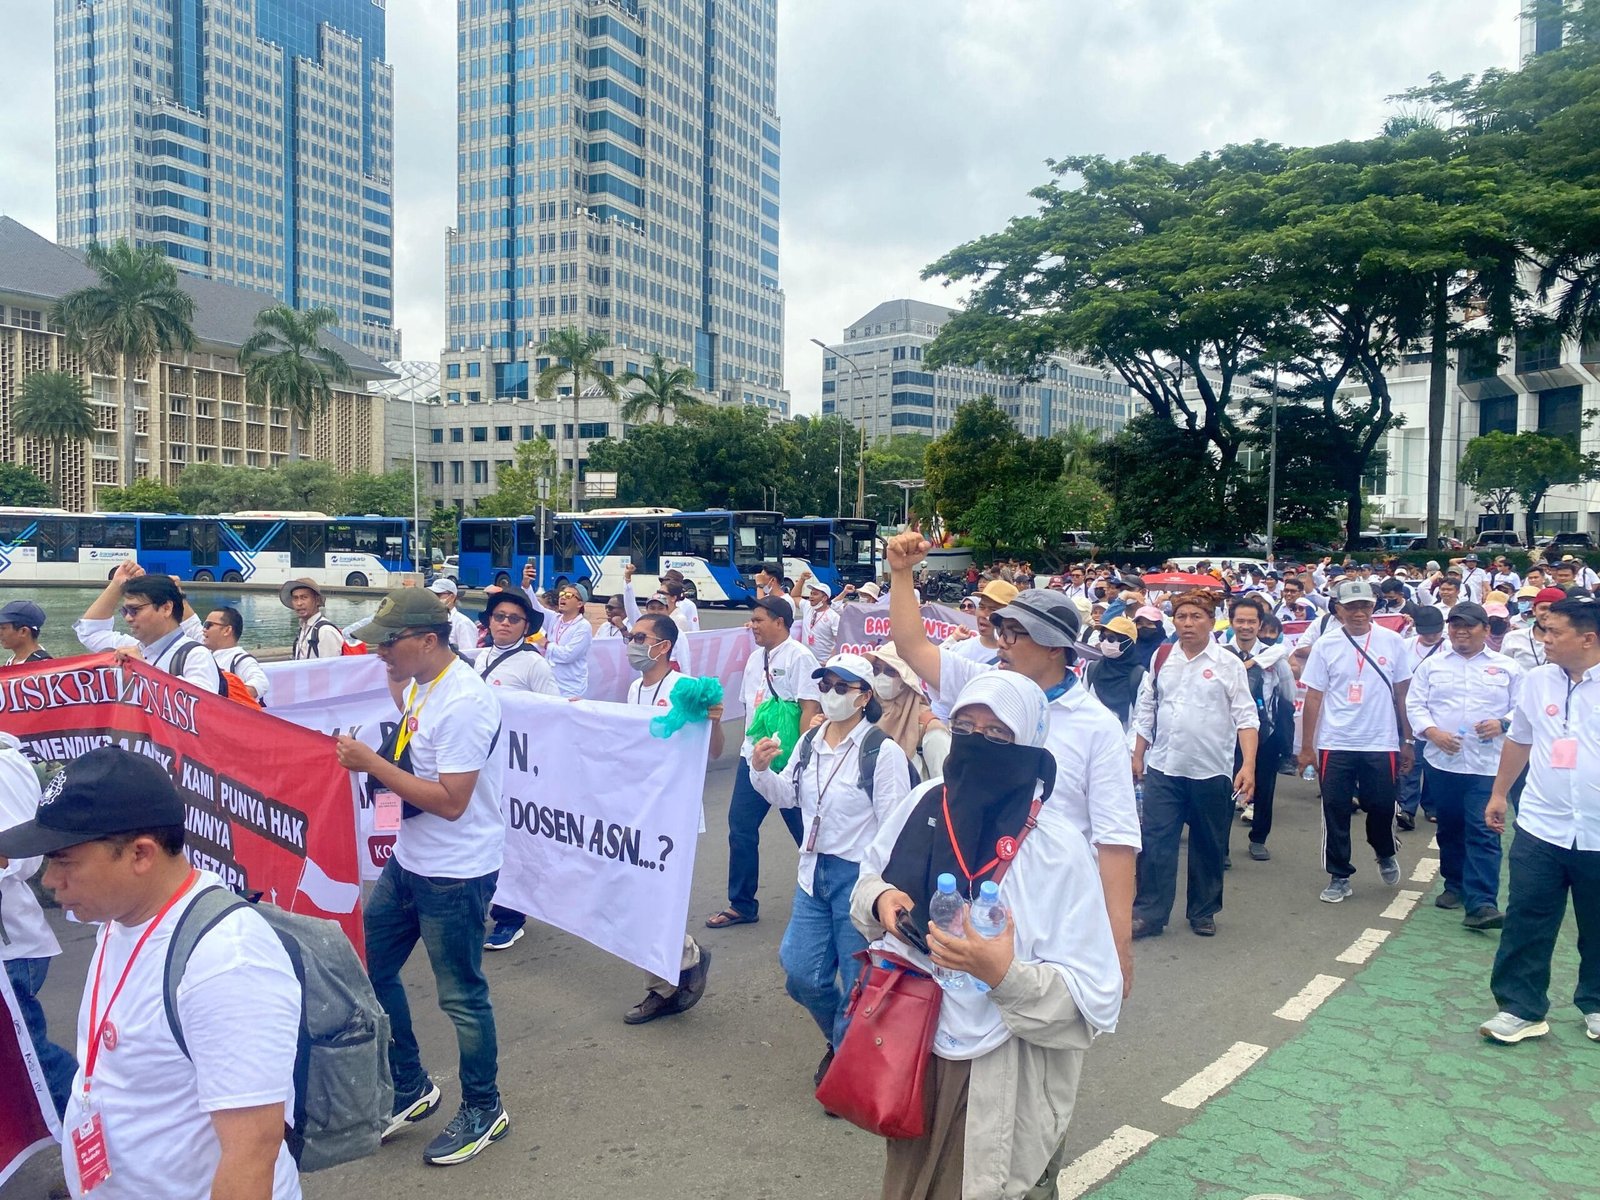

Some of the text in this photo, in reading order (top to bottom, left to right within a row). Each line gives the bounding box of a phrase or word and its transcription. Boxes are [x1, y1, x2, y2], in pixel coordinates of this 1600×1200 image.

[181, 762, 215, 802] KAMI
[220, 781, 268, 831] PUNYA
[269, 806, 304, 849] HAK
[509, 796, 585, 849] DOSEN
